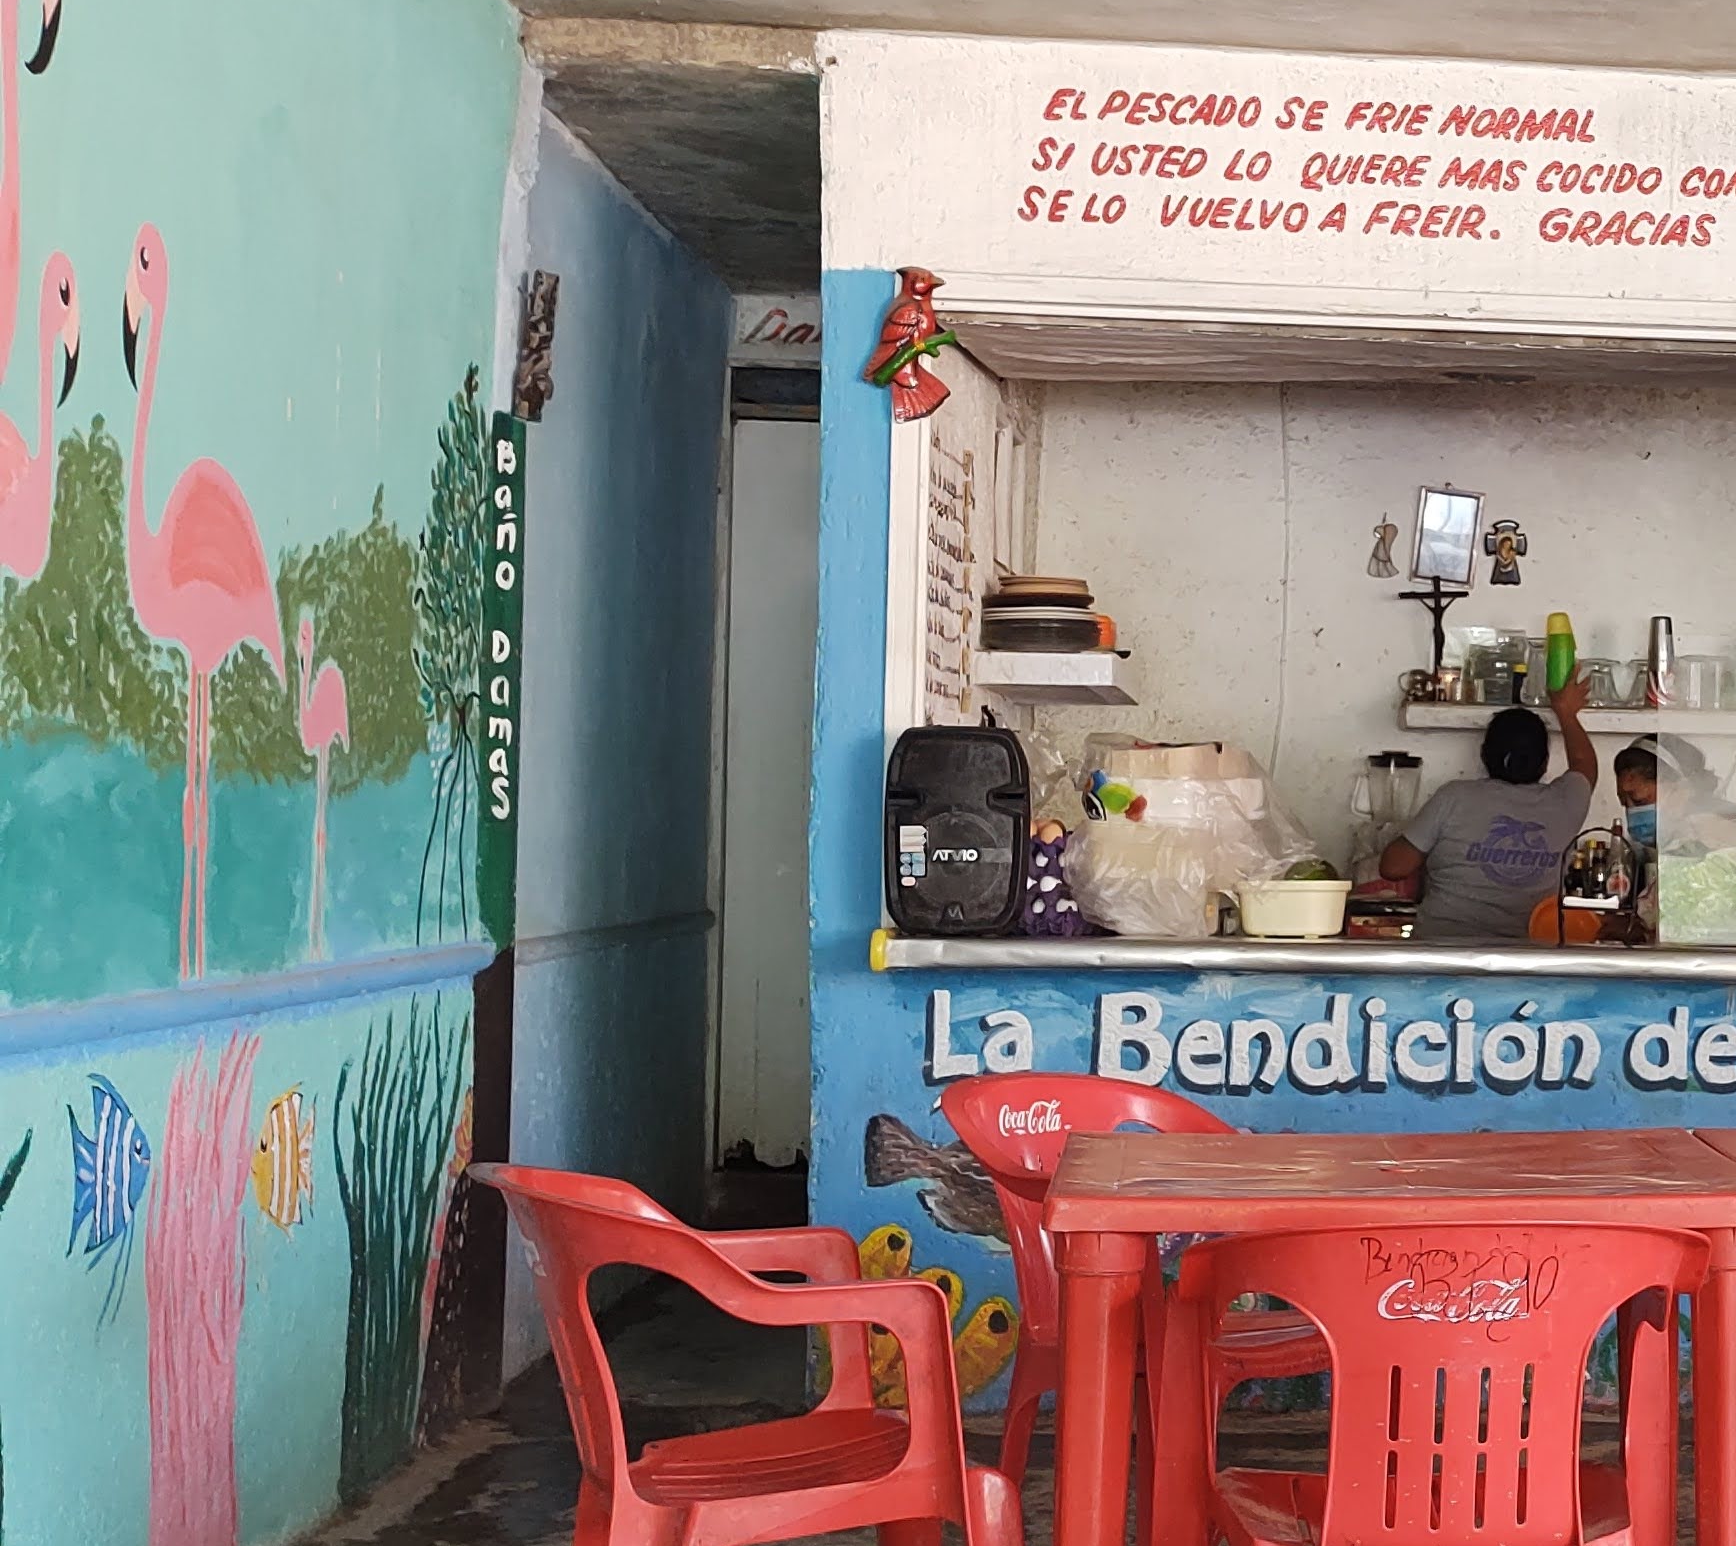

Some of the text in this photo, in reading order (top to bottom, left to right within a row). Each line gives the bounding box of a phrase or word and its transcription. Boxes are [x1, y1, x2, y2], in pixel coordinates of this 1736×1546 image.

[1043, 88, 1595, 143] EL PESCADO SE FRIE NORMAL
[1032, 137, 1076, 172] SI
[1091, 143, 1208, 180] USTED
[1224, 149, 1272, 182] LO
[1300, 152, 1431, 191] QUIERE
[1439, 157, 1526, 192] MAS
[1536, 161, 1662, 195] COCIDO
[1018, 185, 1716, 247] SE LO VUELVO A FREIR. GRACIAS
[744, 308, 821, 344] Da
[493, 439, 517, 591] Baño
[932, 848, 979, 862] ATVIO
[930, 988, 1034, 1081] La
[1097, 990, 1602, 1087] Bendición
